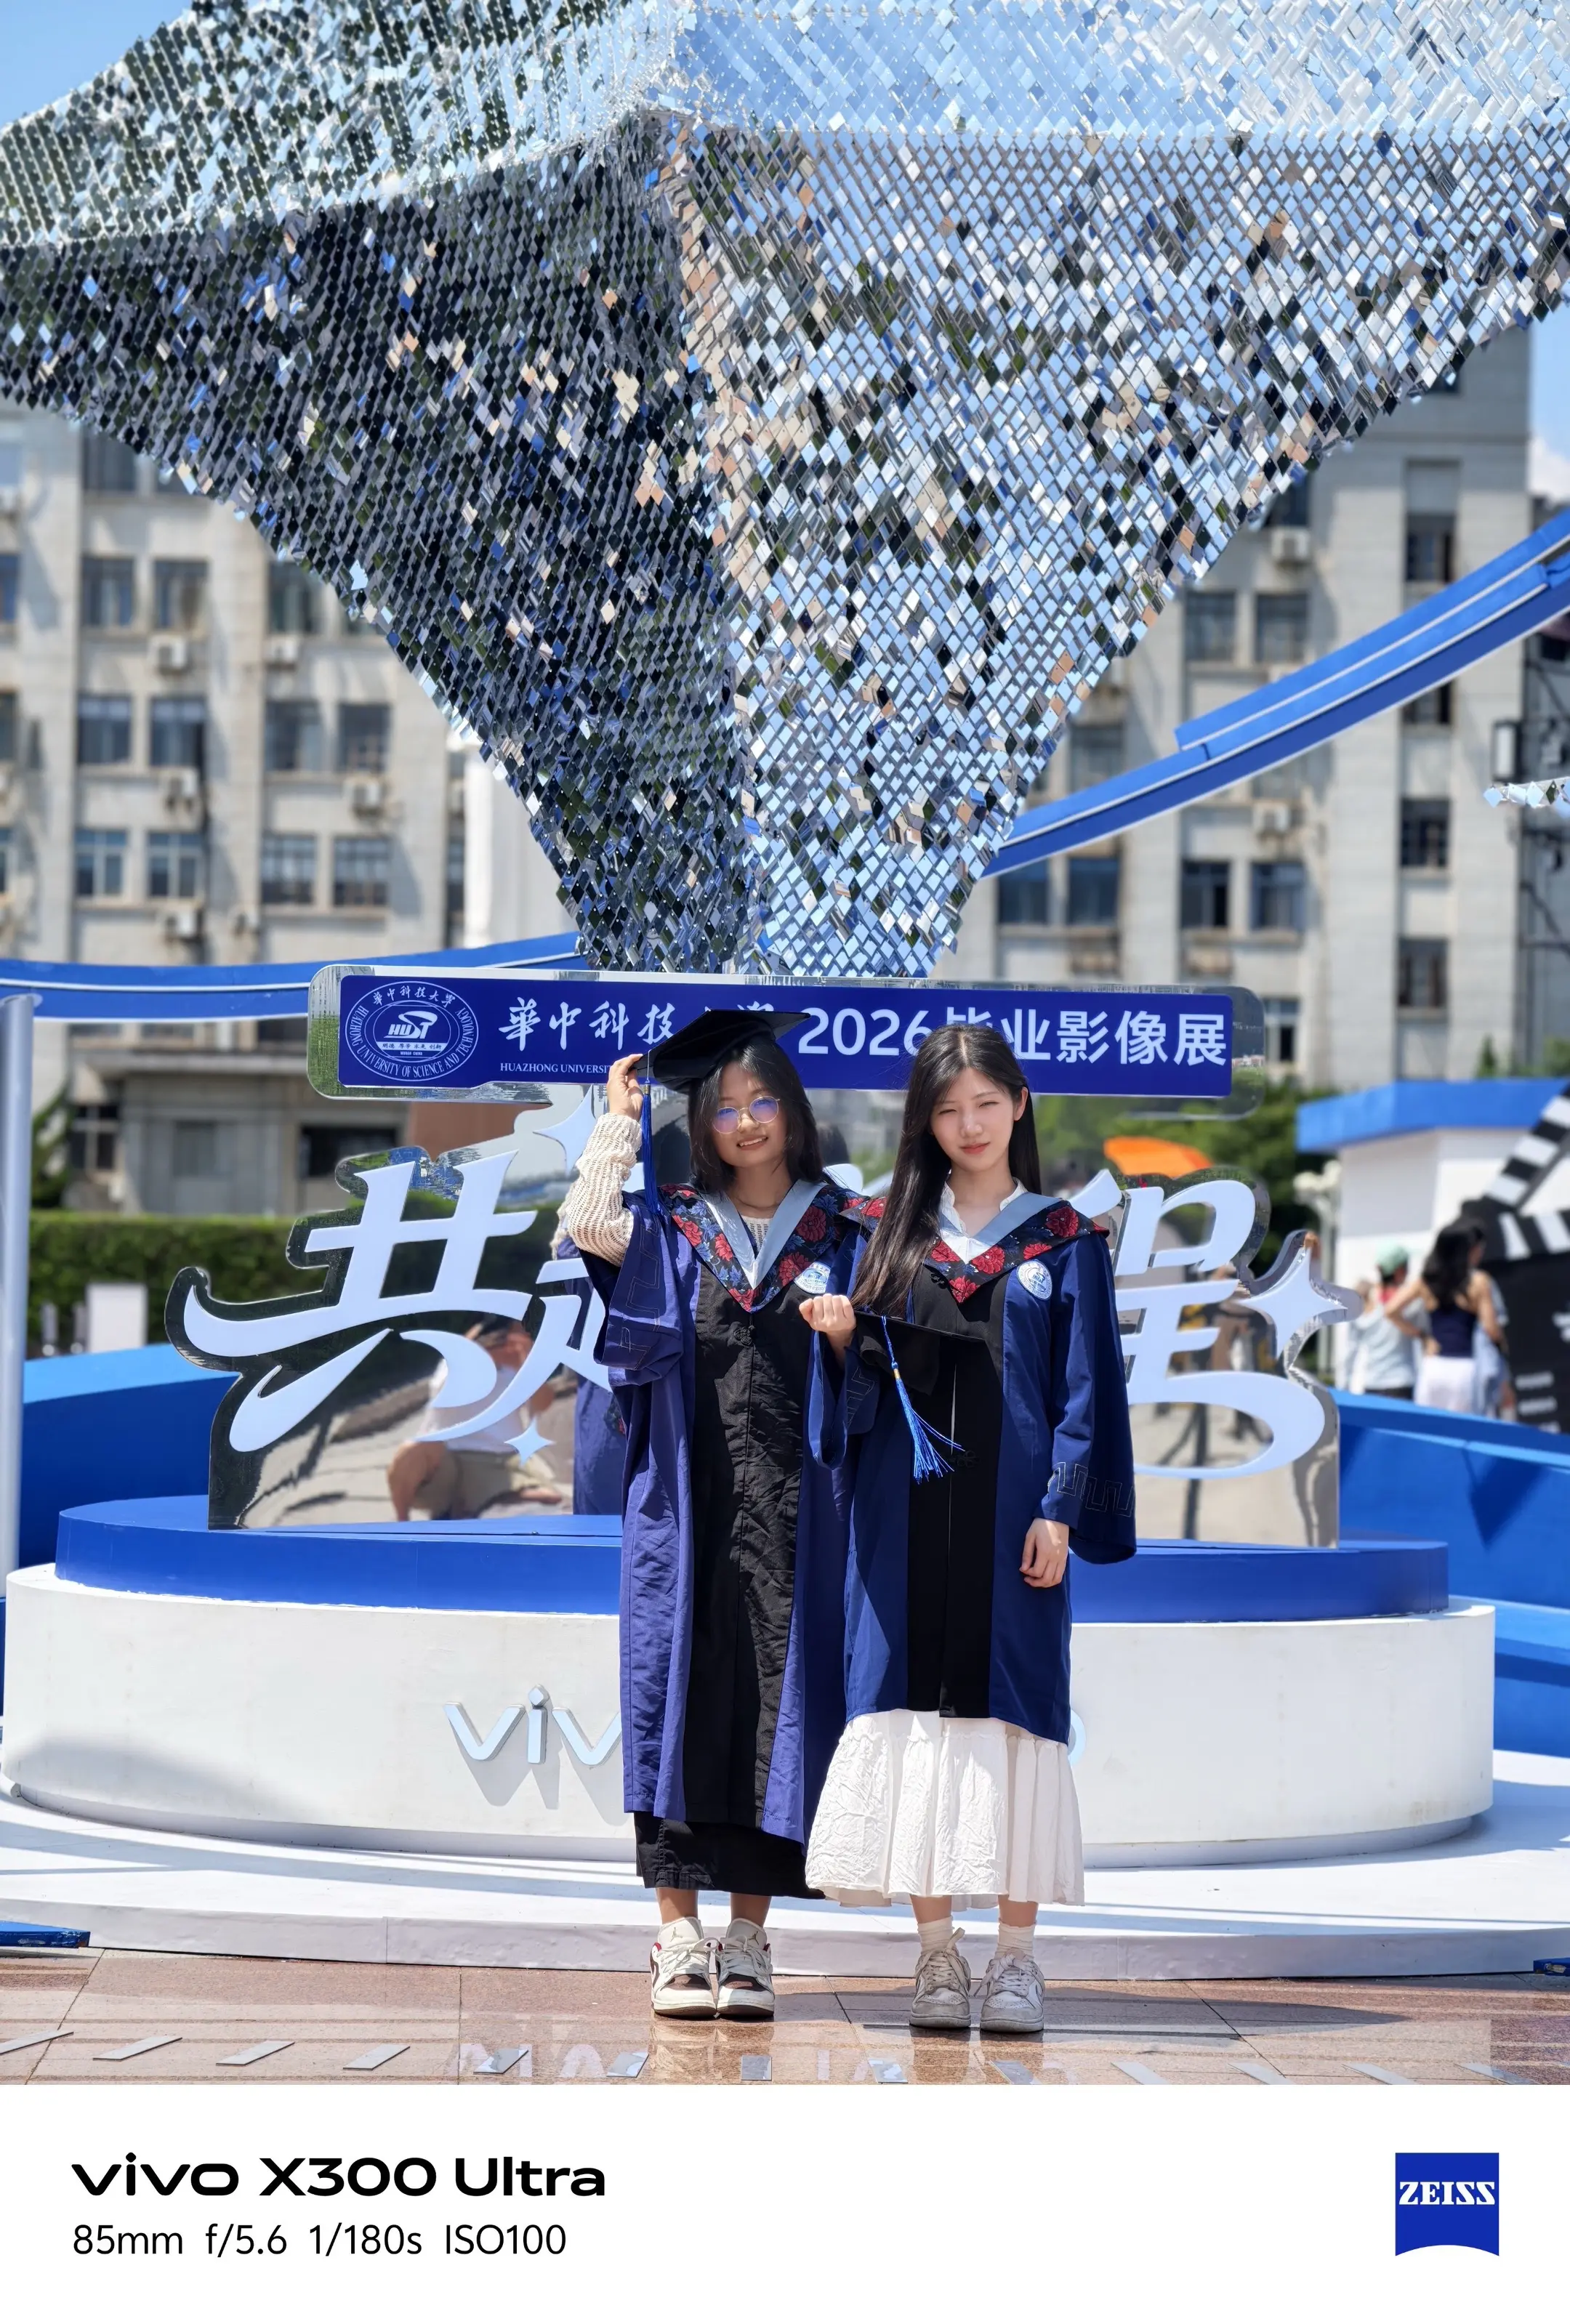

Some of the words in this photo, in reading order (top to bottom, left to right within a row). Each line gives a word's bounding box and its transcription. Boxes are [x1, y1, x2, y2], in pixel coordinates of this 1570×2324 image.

[350, 1005, 369, 1046] HUAZHONG
[384, 1010, 438, 1039] HUST
[456, 1007, 474, 1057] TECHNOLOGY
[357, 1045, 400, 1076] UNIVERSITY
[402, 1065, 411, 1077] OF
[413, 1060, 444, 1078] SCIENCE
[445, 1052, 460, 1072] AND
[500, 1062, 558, 1073] HUAZHONG
[560, 1064, 611, 1073] UNIVERSI
[443, 1685, 622, 1766] viv
